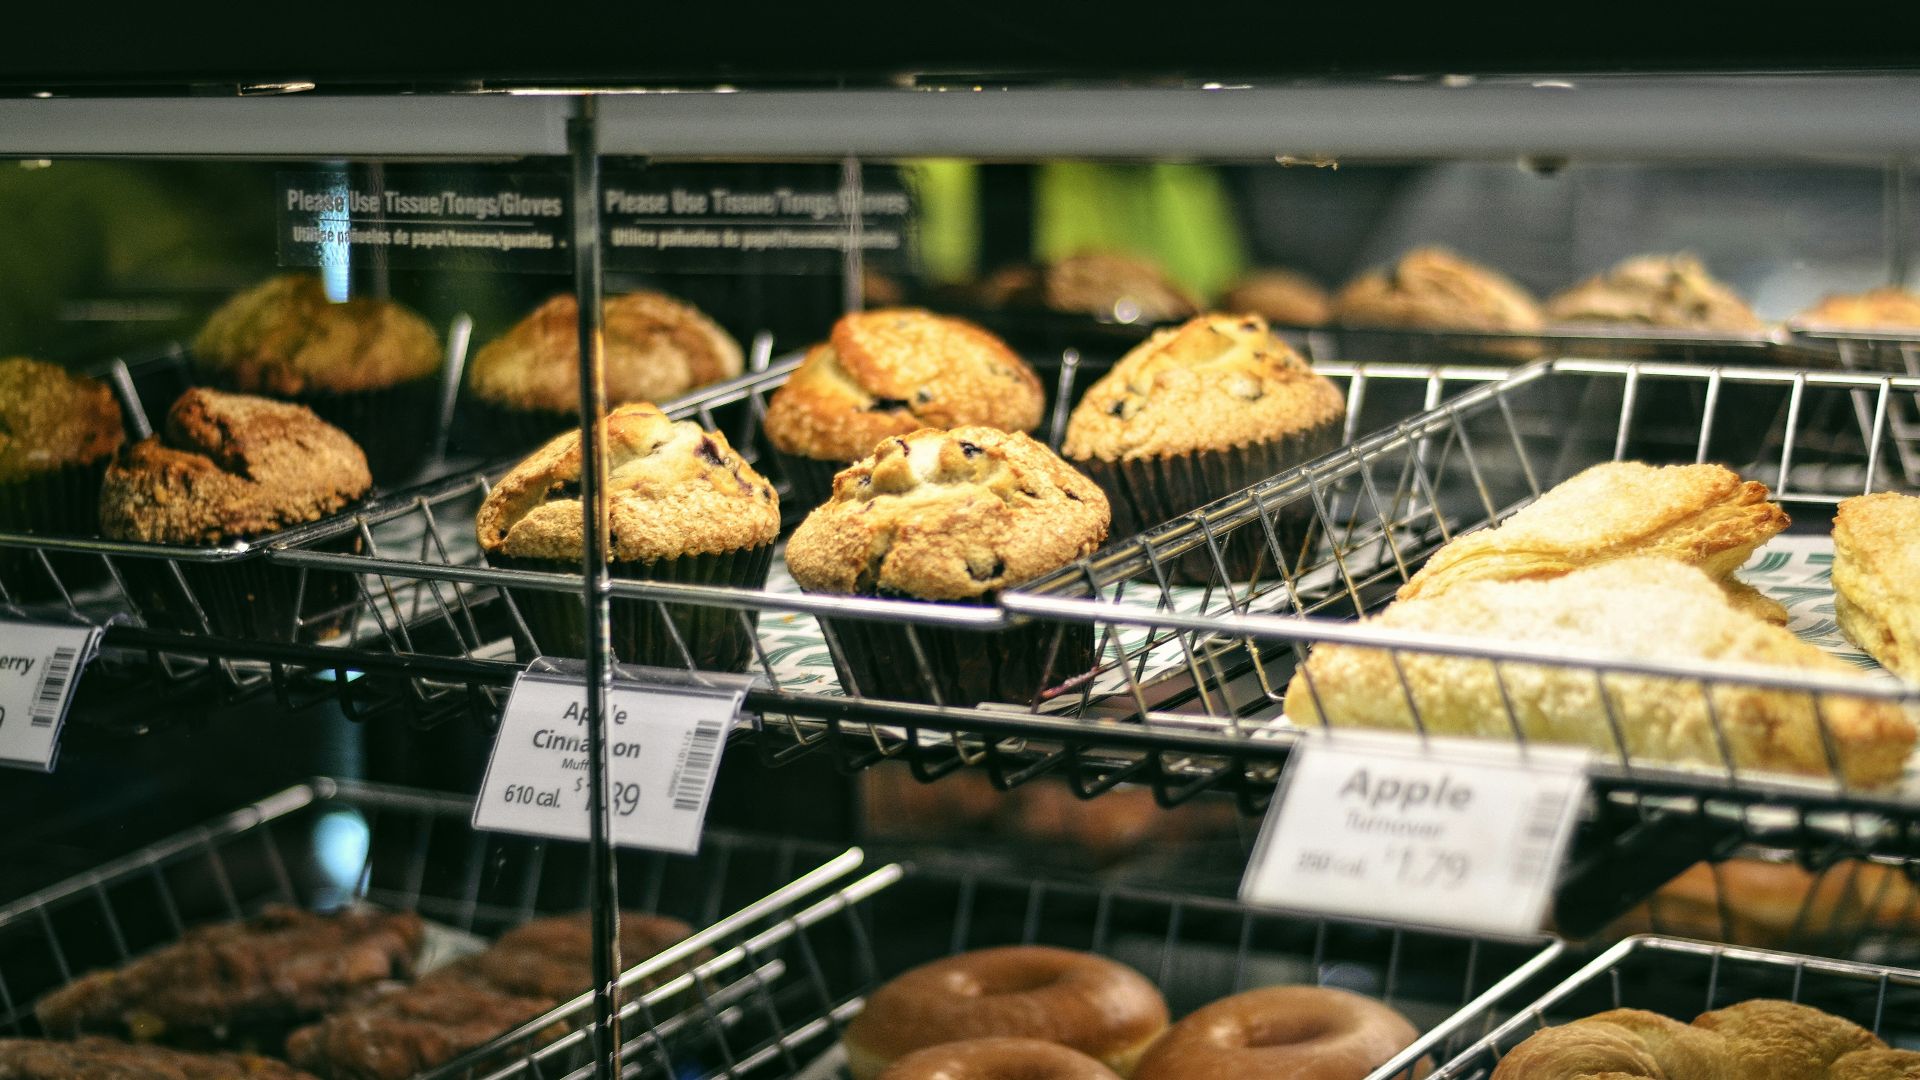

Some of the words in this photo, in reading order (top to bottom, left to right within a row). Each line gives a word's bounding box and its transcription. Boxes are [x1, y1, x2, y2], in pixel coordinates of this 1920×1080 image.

[287, 189, 345, 213] Please
[349, 190, 380, 214] Use
[384, 190, 563, 220] Tissue/Tongs/Gloves
[605, 188, 668, 214] Please
[671, 188, 708, 214] Use
[393, 228, 410, 245] de
[562, 701, 628, 728] Ape
[504, 784, 534, 804] 610
[536, 788, 560, 808] cal.
[1339, 766, 1474, 811] Apple
[1345, 809, 1445, 840] Turnover
